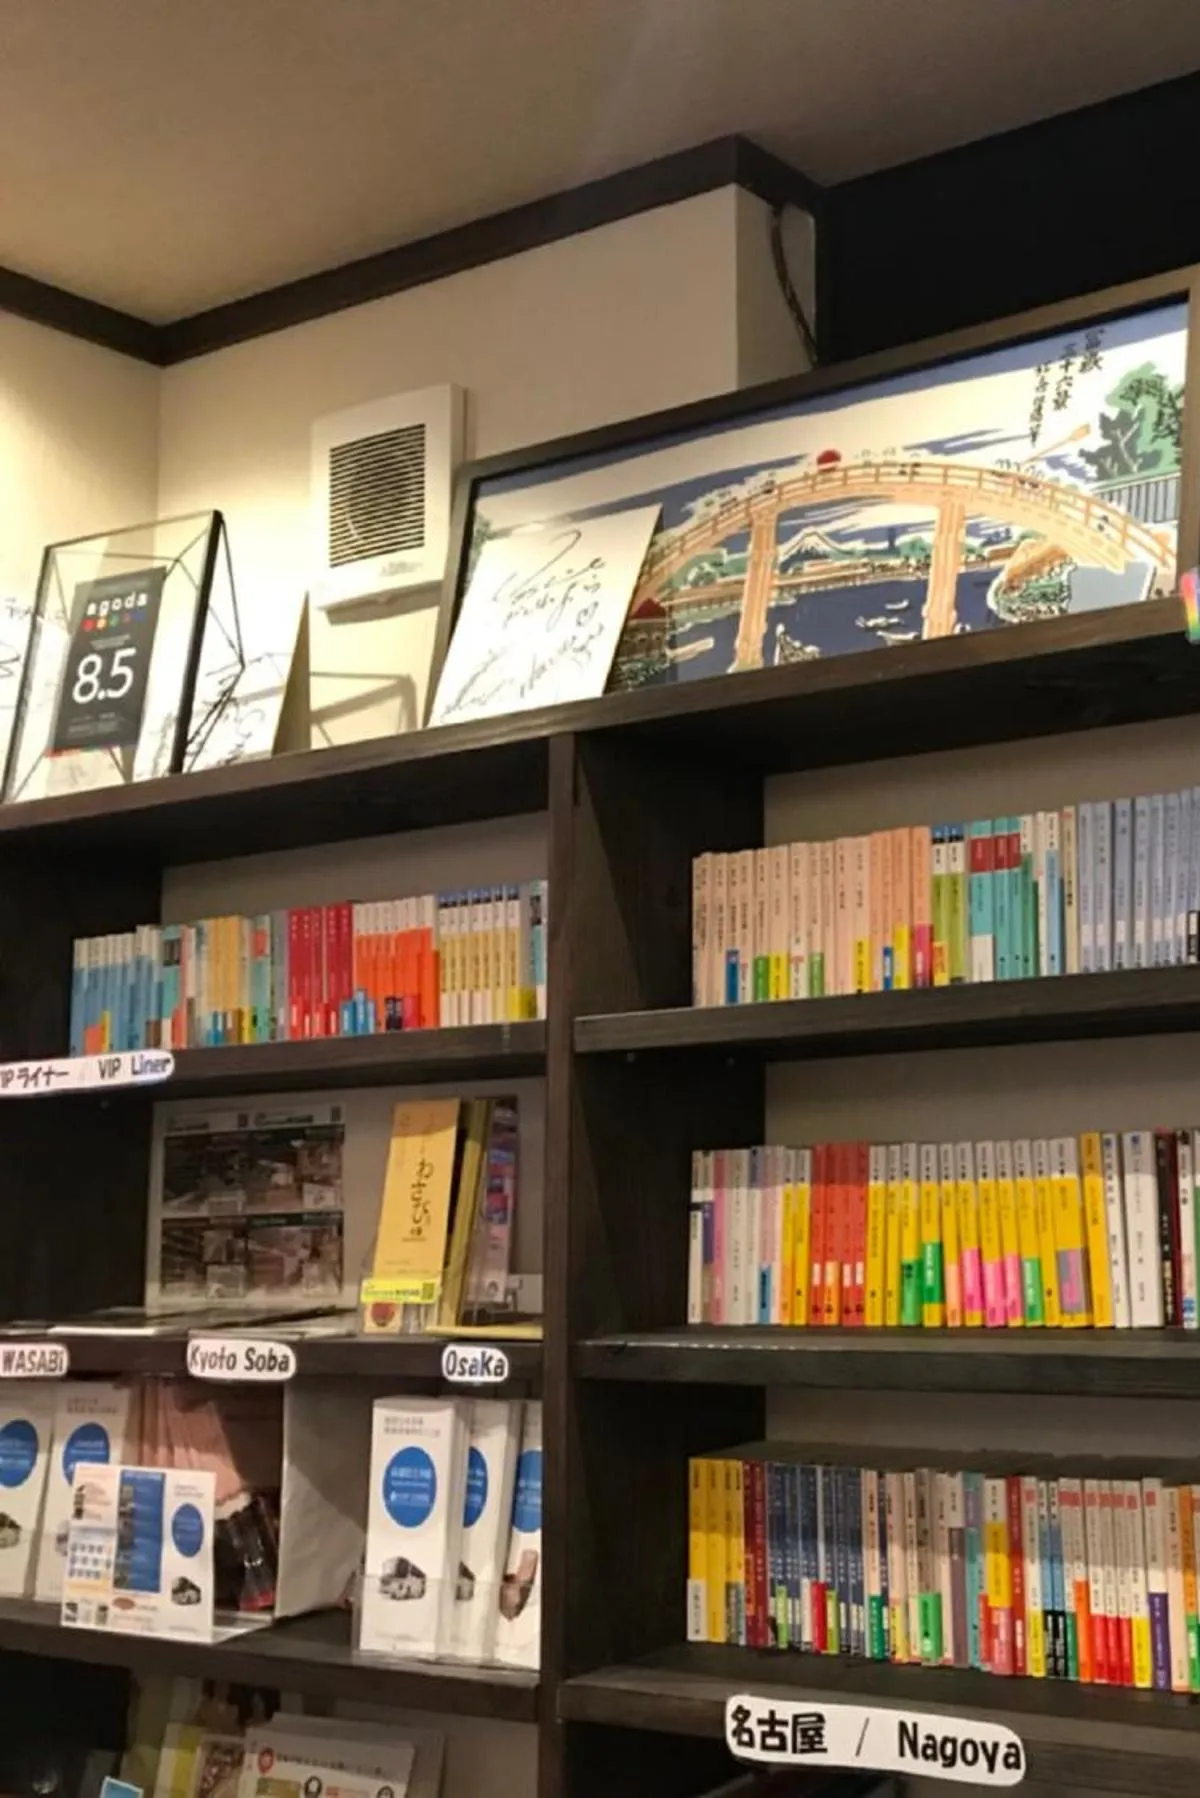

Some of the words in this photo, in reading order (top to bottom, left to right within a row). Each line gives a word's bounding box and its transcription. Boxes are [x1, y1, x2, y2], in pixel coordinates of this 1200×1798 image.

[86, 592, 149, 616] agoda
[72, 647, 137, 704] 8.5
[0, 1067, 69, 1088] IPライナー
[98, 1058, 121, 1080] VIP
[131, 1054, 170, 1076] Liner
[189, 1346, 237, 1373] Kyoto
[243, 1346, 290, 1372] Soba
[446, 1350, 505, 1377] Osaka
[731, 1705, 828, 1755] 名古屋
[898, 1720, 1022, 1773] Nagoya
